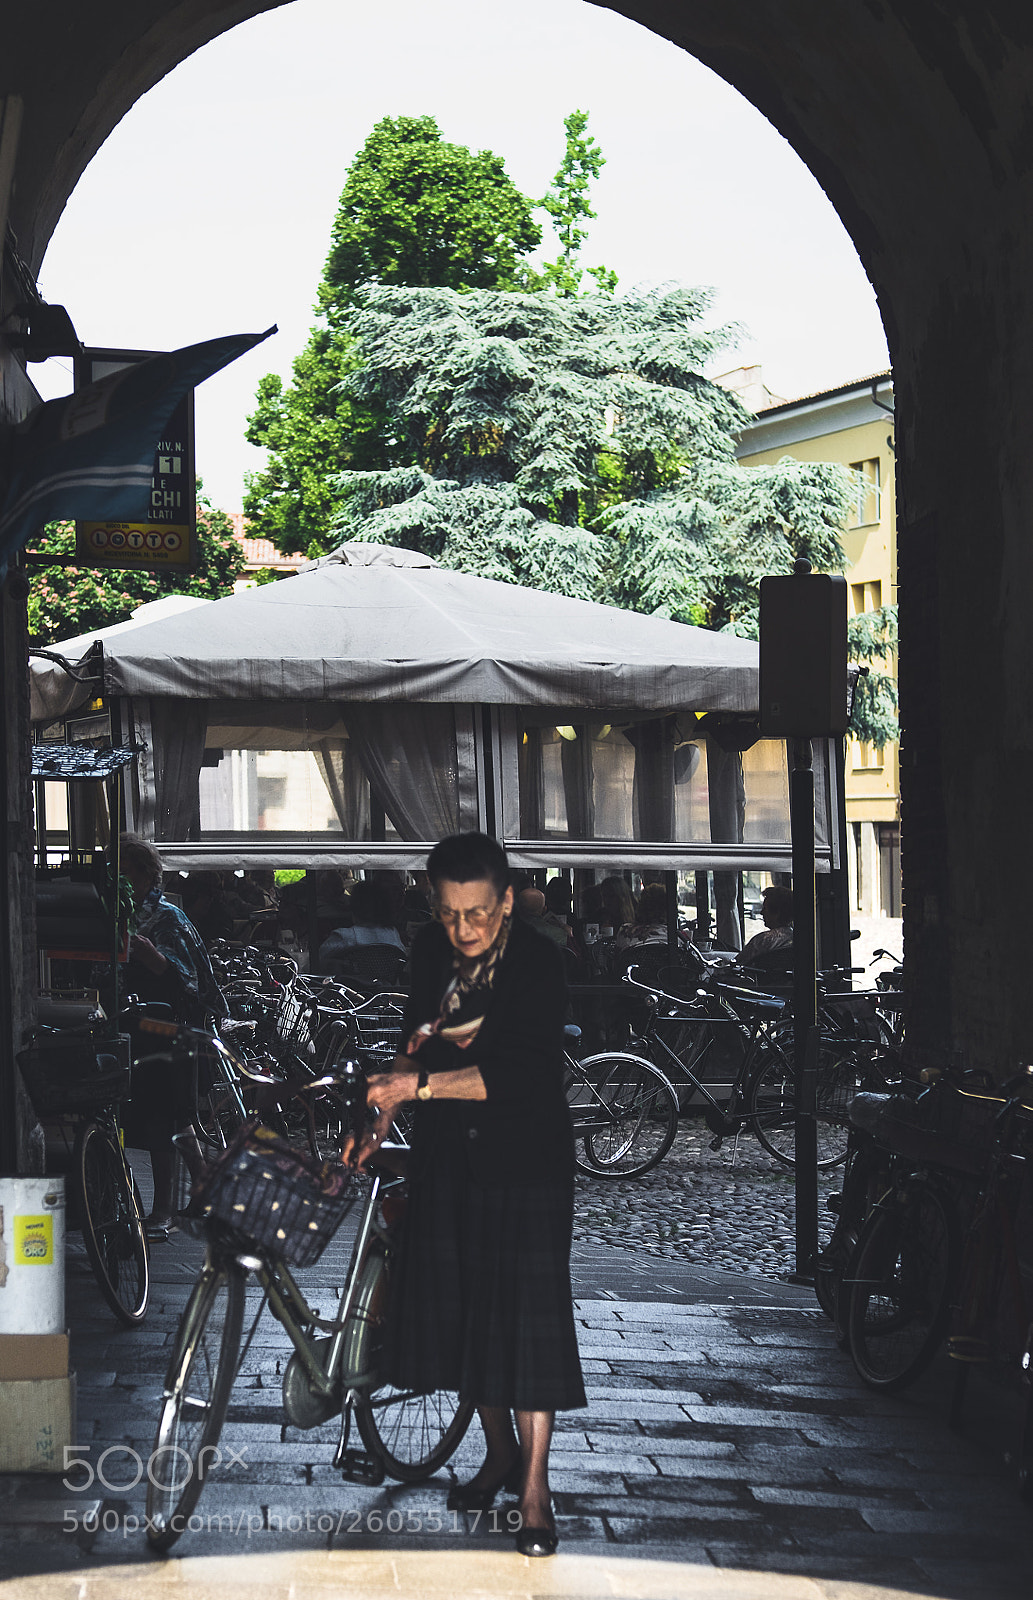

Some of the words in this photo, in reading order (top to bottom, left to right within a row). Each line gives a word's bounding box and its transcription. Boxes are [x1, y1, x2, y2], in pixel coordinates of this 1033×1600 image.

[175, 442, 185, 452] N.
[165, 457, 174, 473] 1
[160, 479, 167, 489] E
[151, 490, 181, 508] CHI
[93, 531, 178, 549] LOTTO
[23, 1247, 47, 1258] ORO
